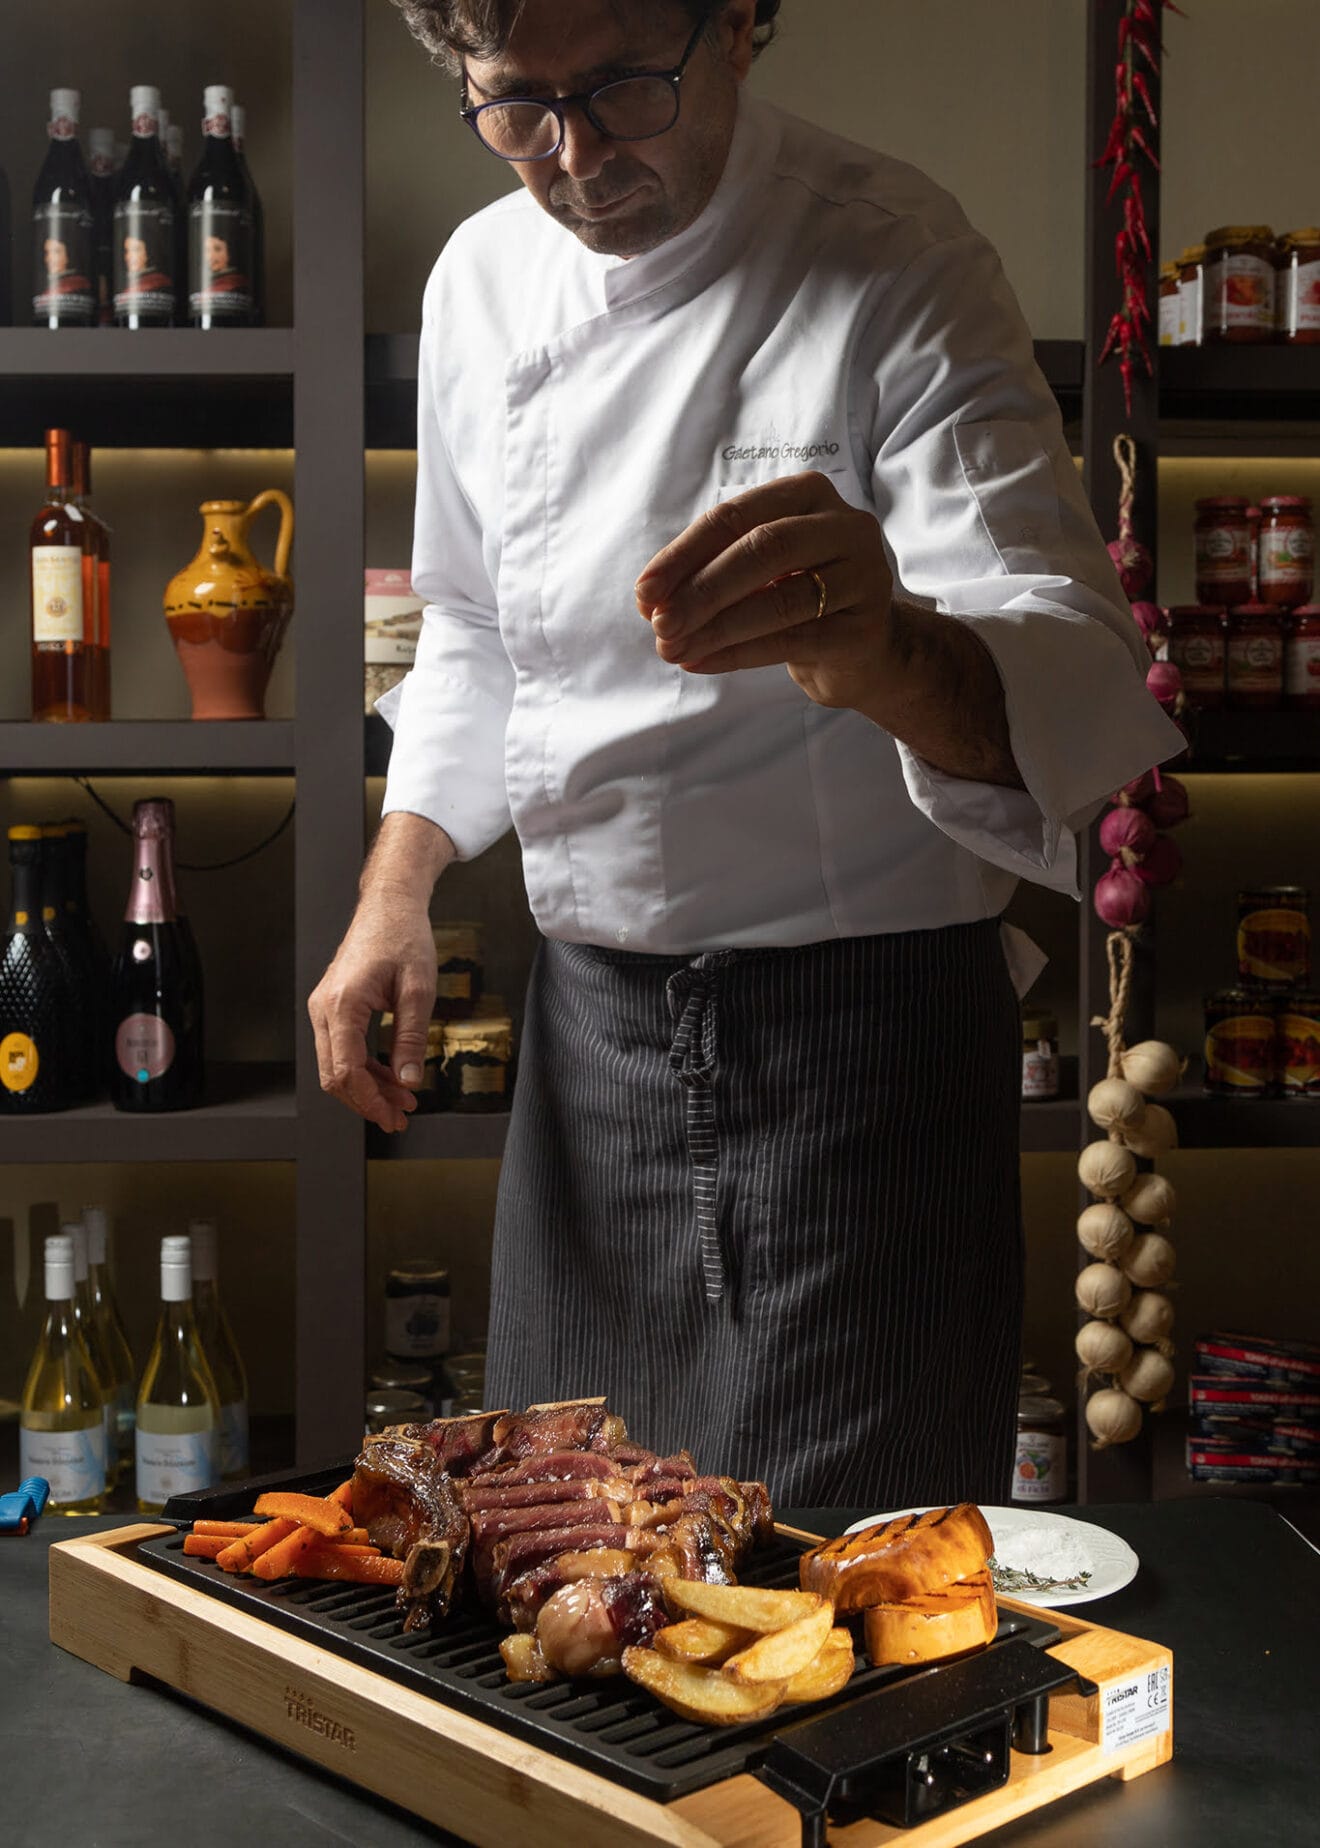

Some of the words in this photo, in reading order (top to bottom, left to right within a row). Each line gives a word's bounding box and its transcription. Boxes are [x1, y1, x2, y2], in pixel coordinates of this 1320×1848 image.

[722, 445, 779, 461] Gaetano
[780, 440, 840, 462] Gregorio
[284, 1695, 357, 1752] TRISTAR
